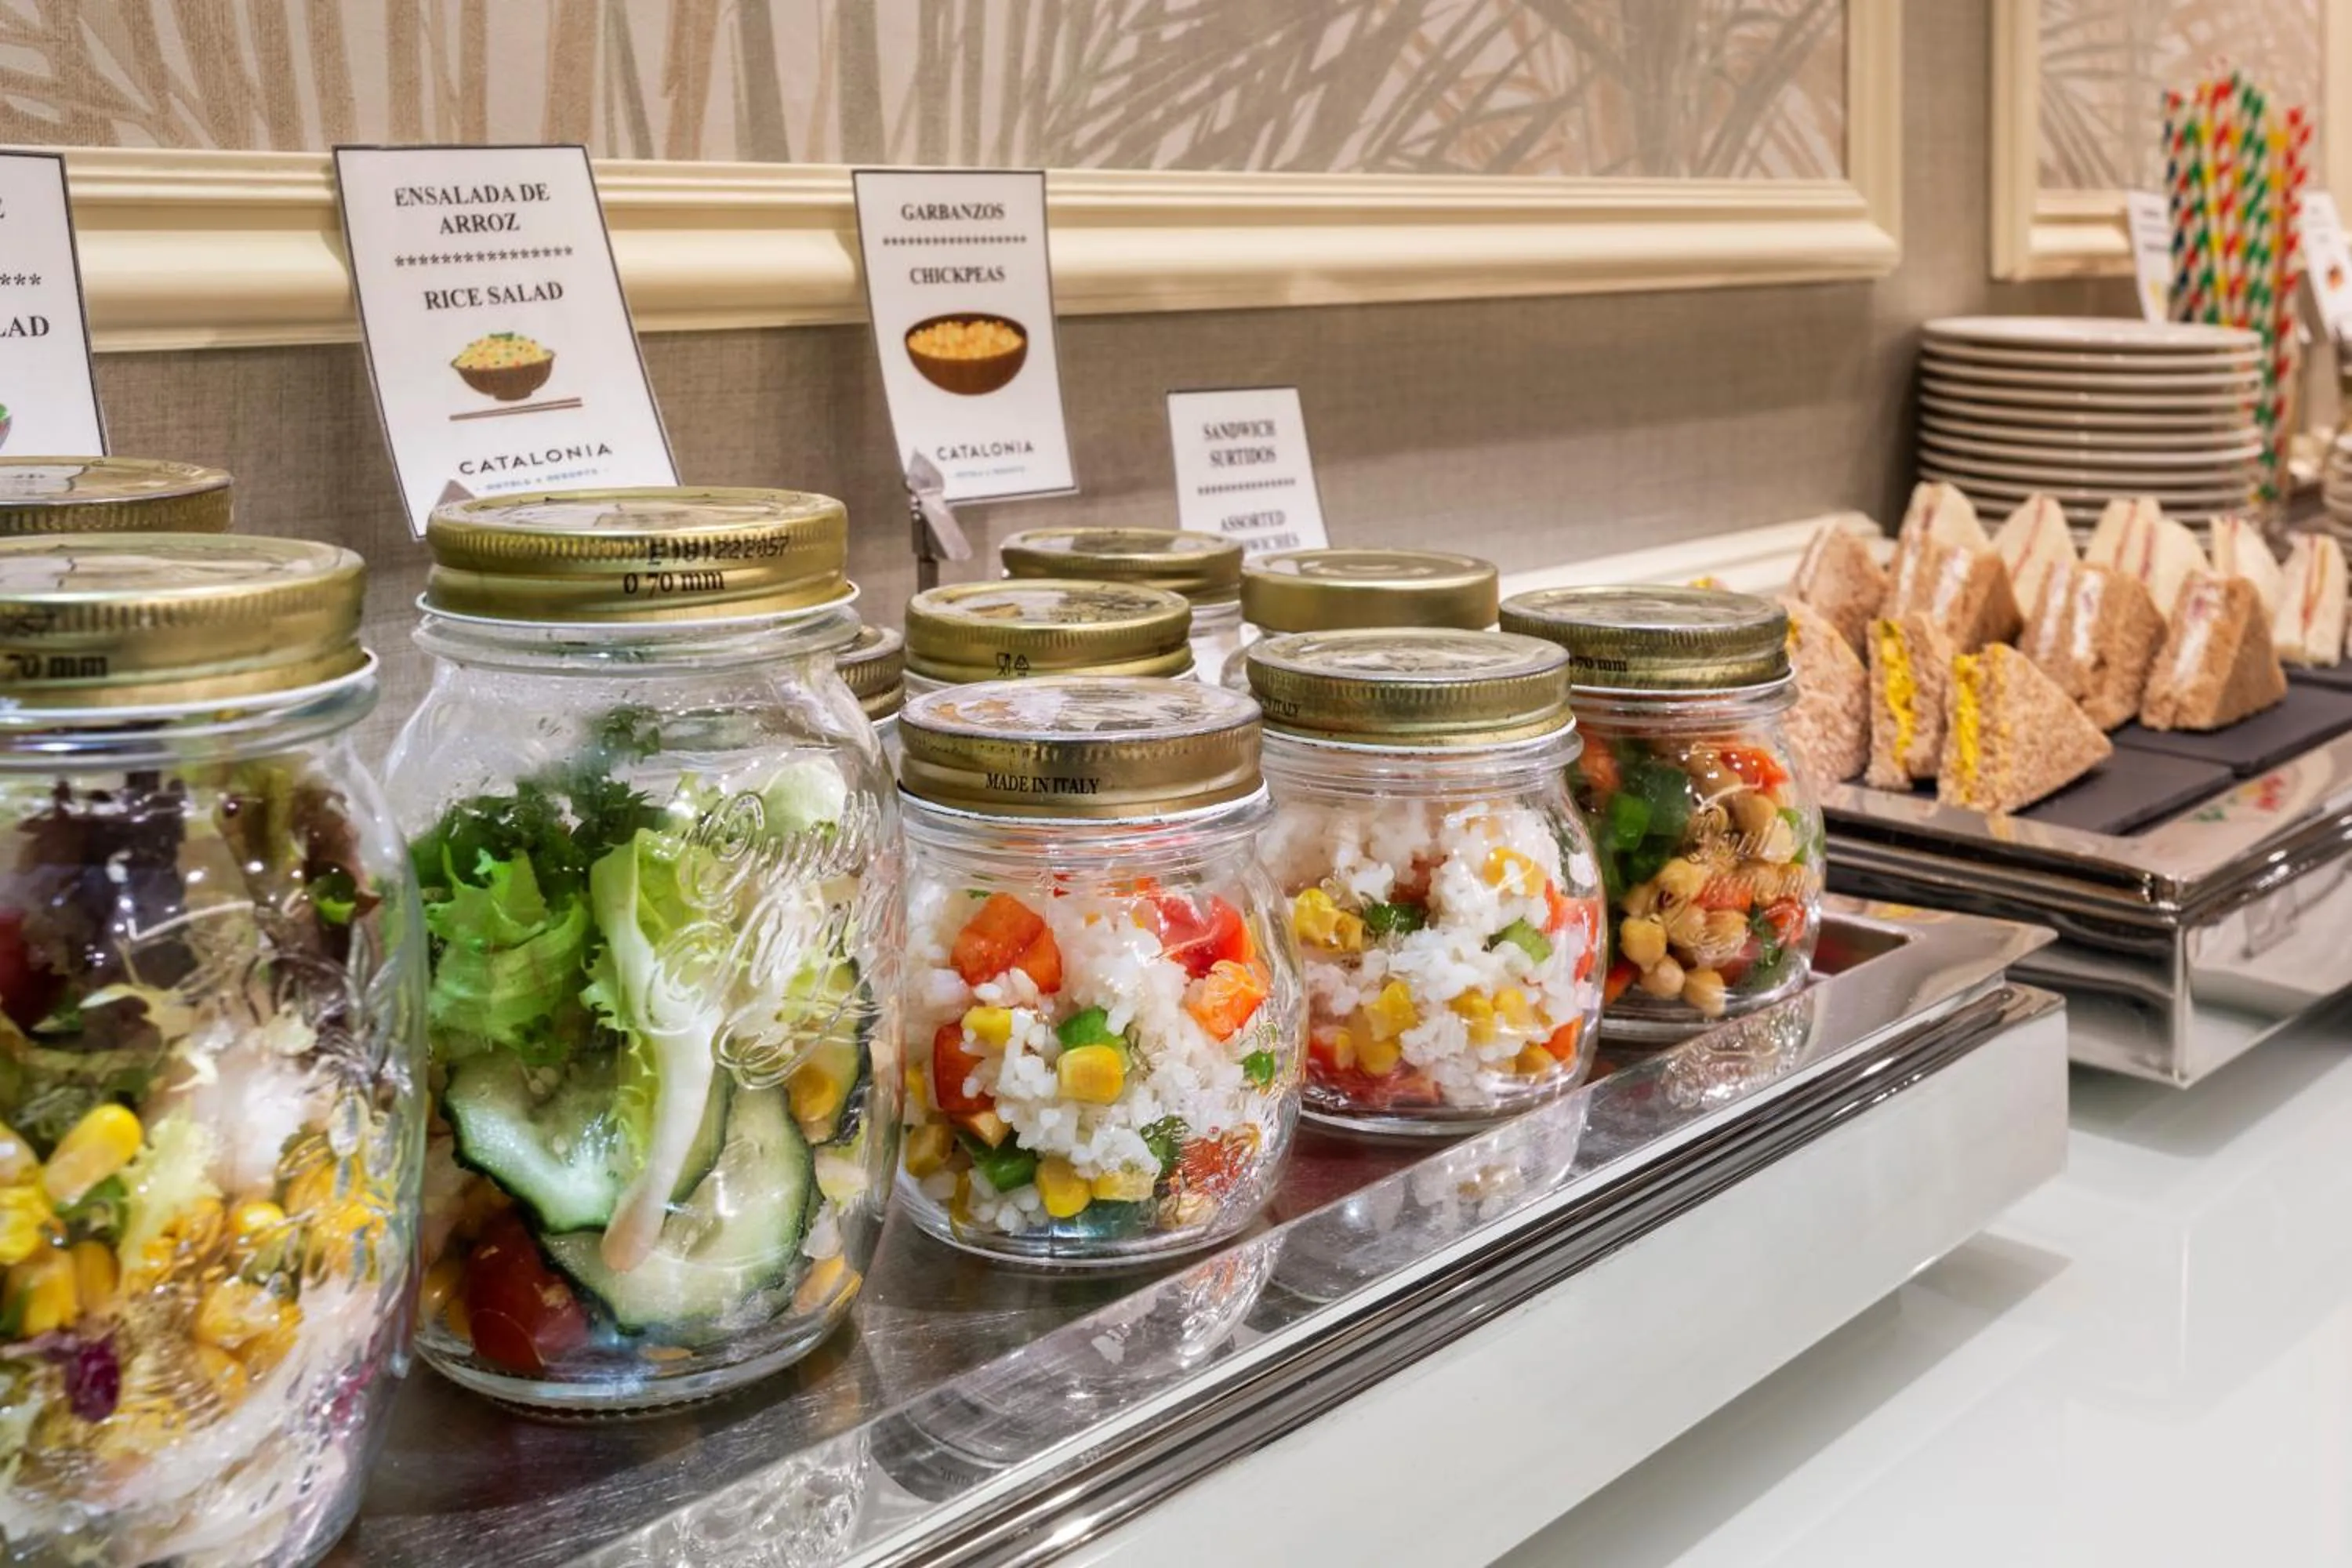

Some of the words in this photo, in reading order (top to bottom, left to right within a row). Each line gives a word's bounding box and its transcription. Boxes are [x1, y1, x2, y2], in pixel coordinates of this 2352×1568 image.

[394, 186, 516, 207] ENSALADA
[519, 183, 551, 202] DE
[440, 212, 521, 234] ARROZ
[902, 203, 1005, 222] GARBANZOS
[909, 265, 1006, 285] CHICKPEAS
[424, 288, 483, 310] RICE
[486, 281, 564, 306] SALAD
[459, 443, 613, 475] CATALONIA
[936, 440, 1034, 461] CATALONIA
[1210, 446, 1276, 466] SURTIDOS
[681, 571, 724, 590] mm
[985, 772, 1028, 793] MADE
[1032, 777, 1049, 793] IN
[1053, 777, 1100, 794] ITALY
